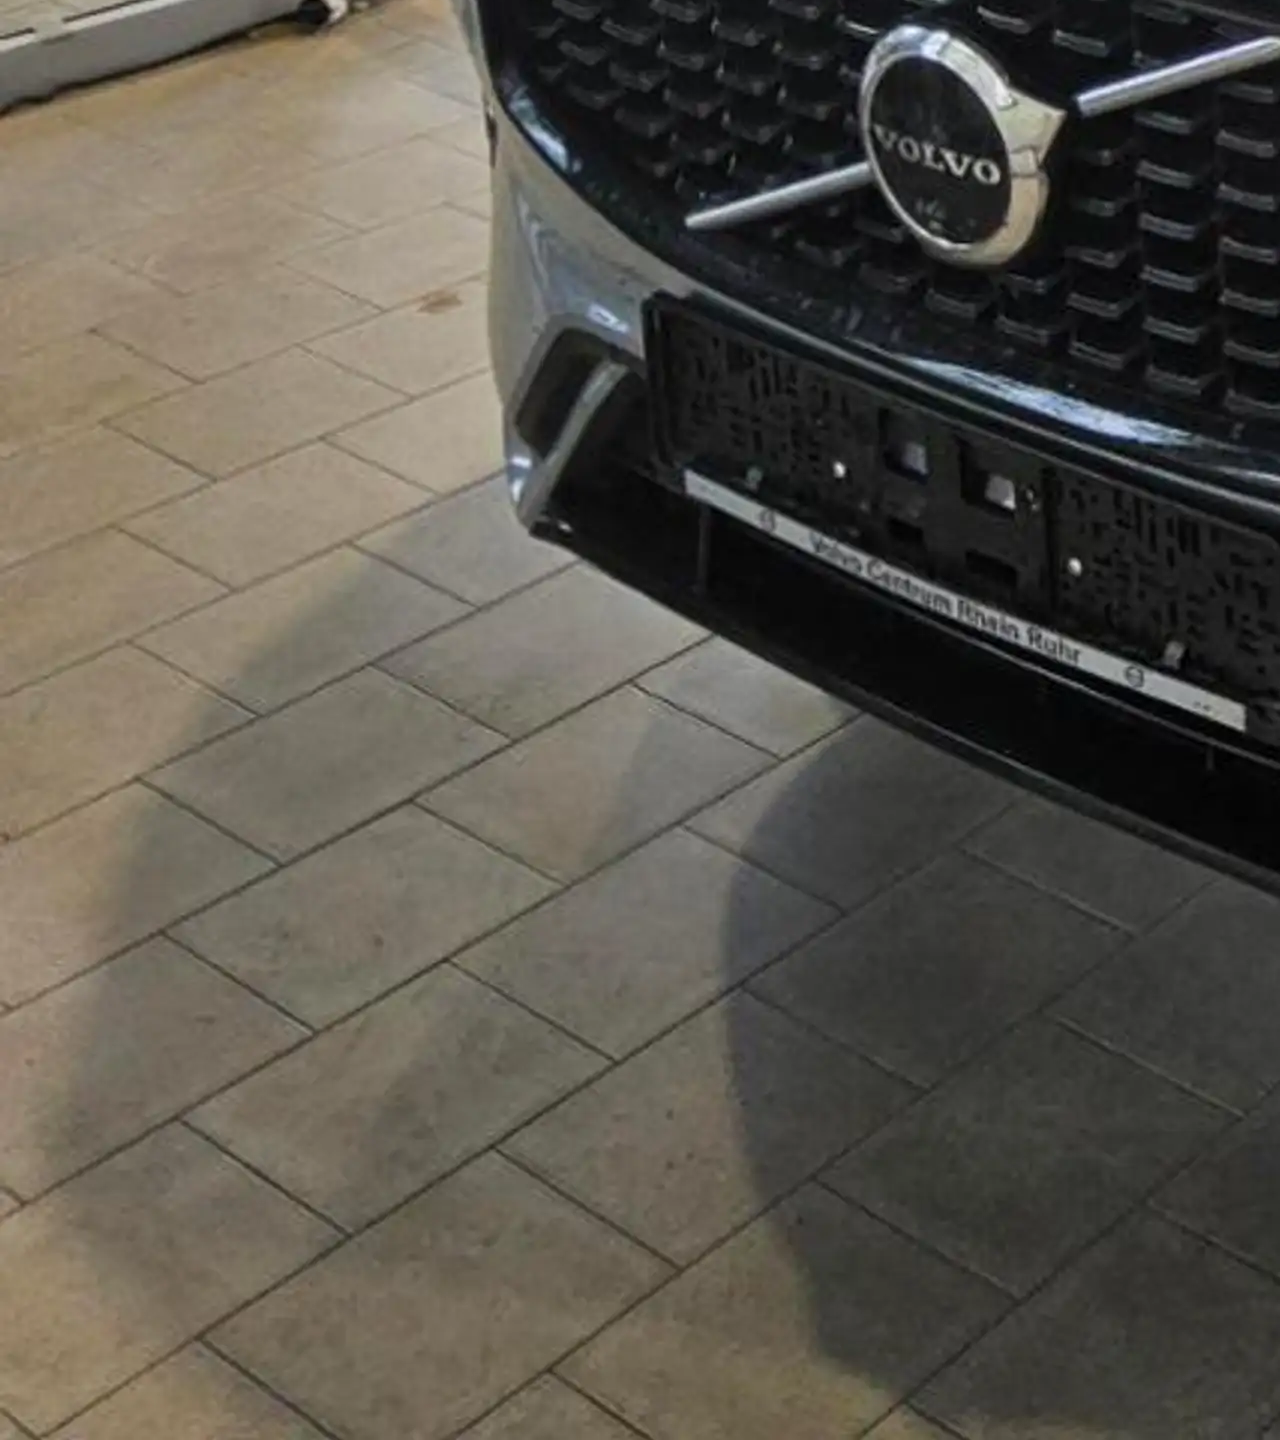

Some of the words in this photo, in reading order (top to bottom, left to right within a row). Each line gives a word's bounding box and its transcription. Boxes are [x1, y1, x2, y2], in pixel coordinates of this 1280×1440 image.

[873, 123, 1001, 185] VOLVO
[809, 531, 863, 574] Volvo
[867, 558, 951, 614] Centrum
[957, 598, 1019, 641] Rhein
[1026, 623, 1080, 666] Ruhr
